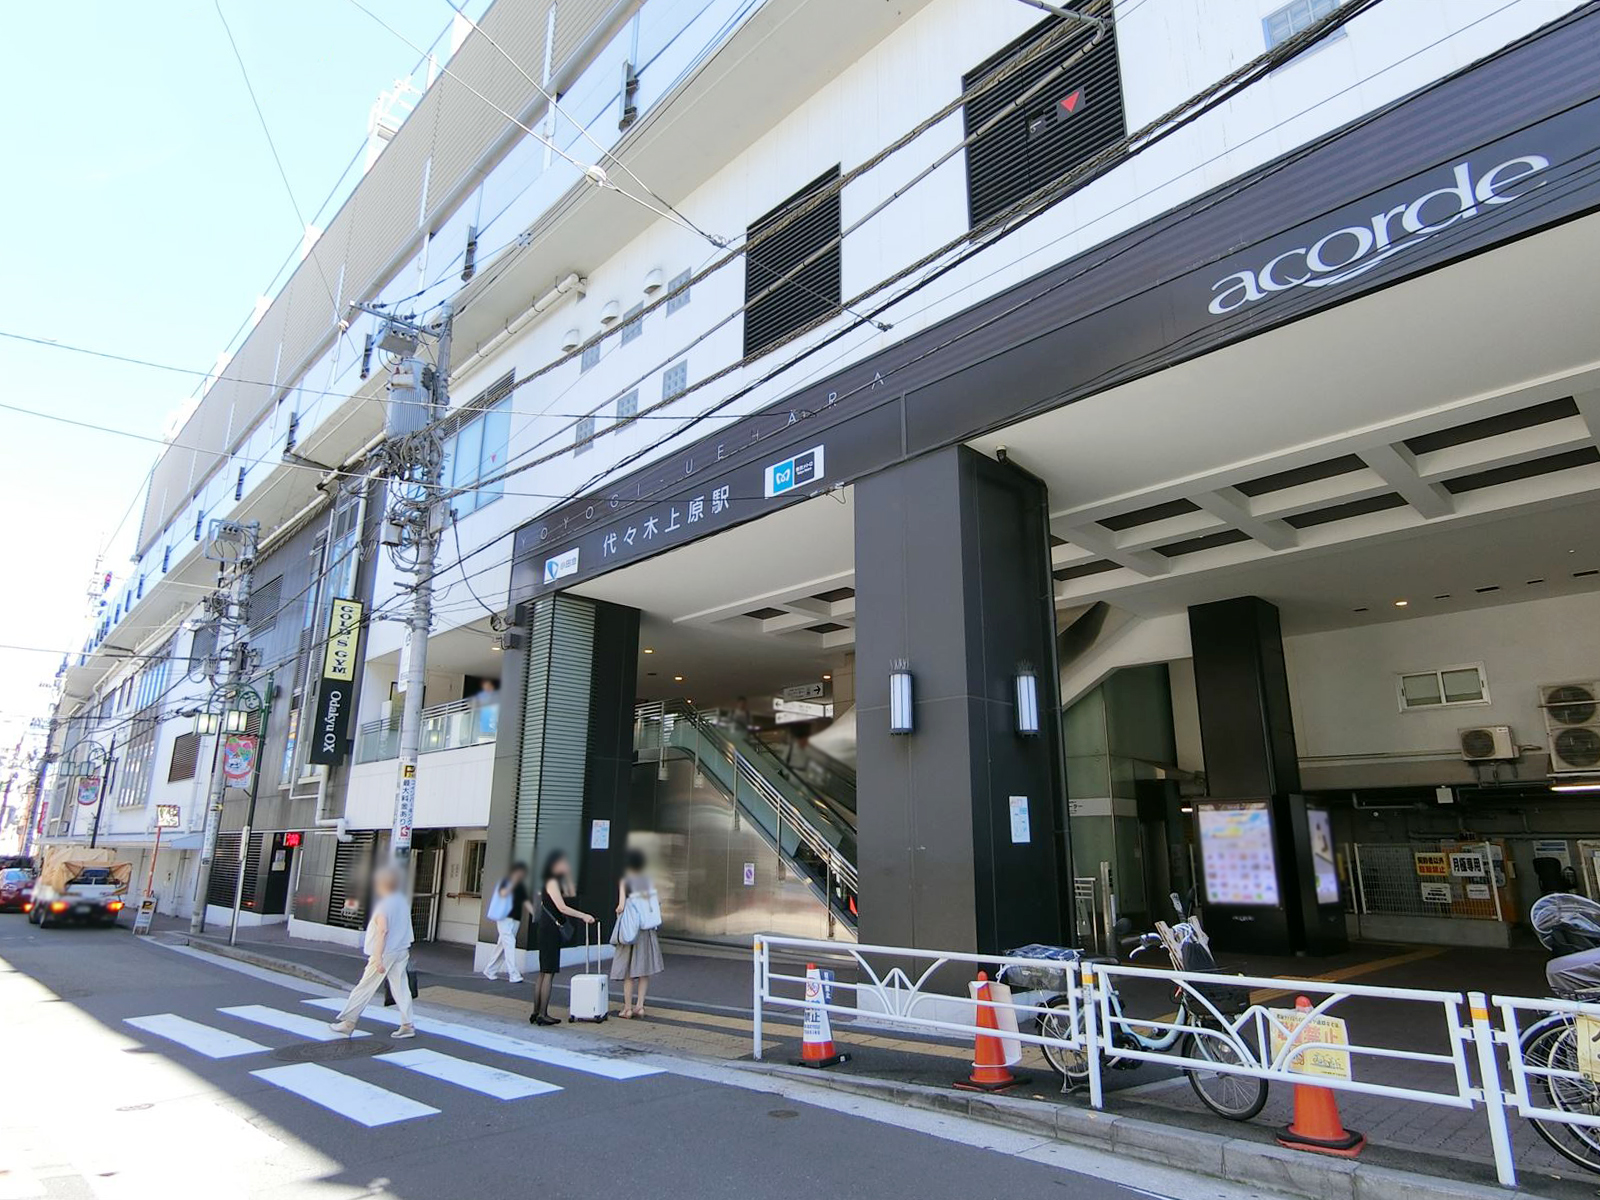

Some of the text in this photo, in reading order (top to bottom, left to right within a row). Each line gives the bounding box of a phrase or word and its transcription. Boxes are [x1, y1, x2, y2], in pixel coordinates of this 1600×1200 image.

[1207, 154, 1551, 315] acorde
[603, 485, 730, 557] 代々木上原駅
[331, 650, 349, 674] GYM
[322, 690, 342, 753] Odakyu OX
[1453, 857, 1481, 872] 月極専用
